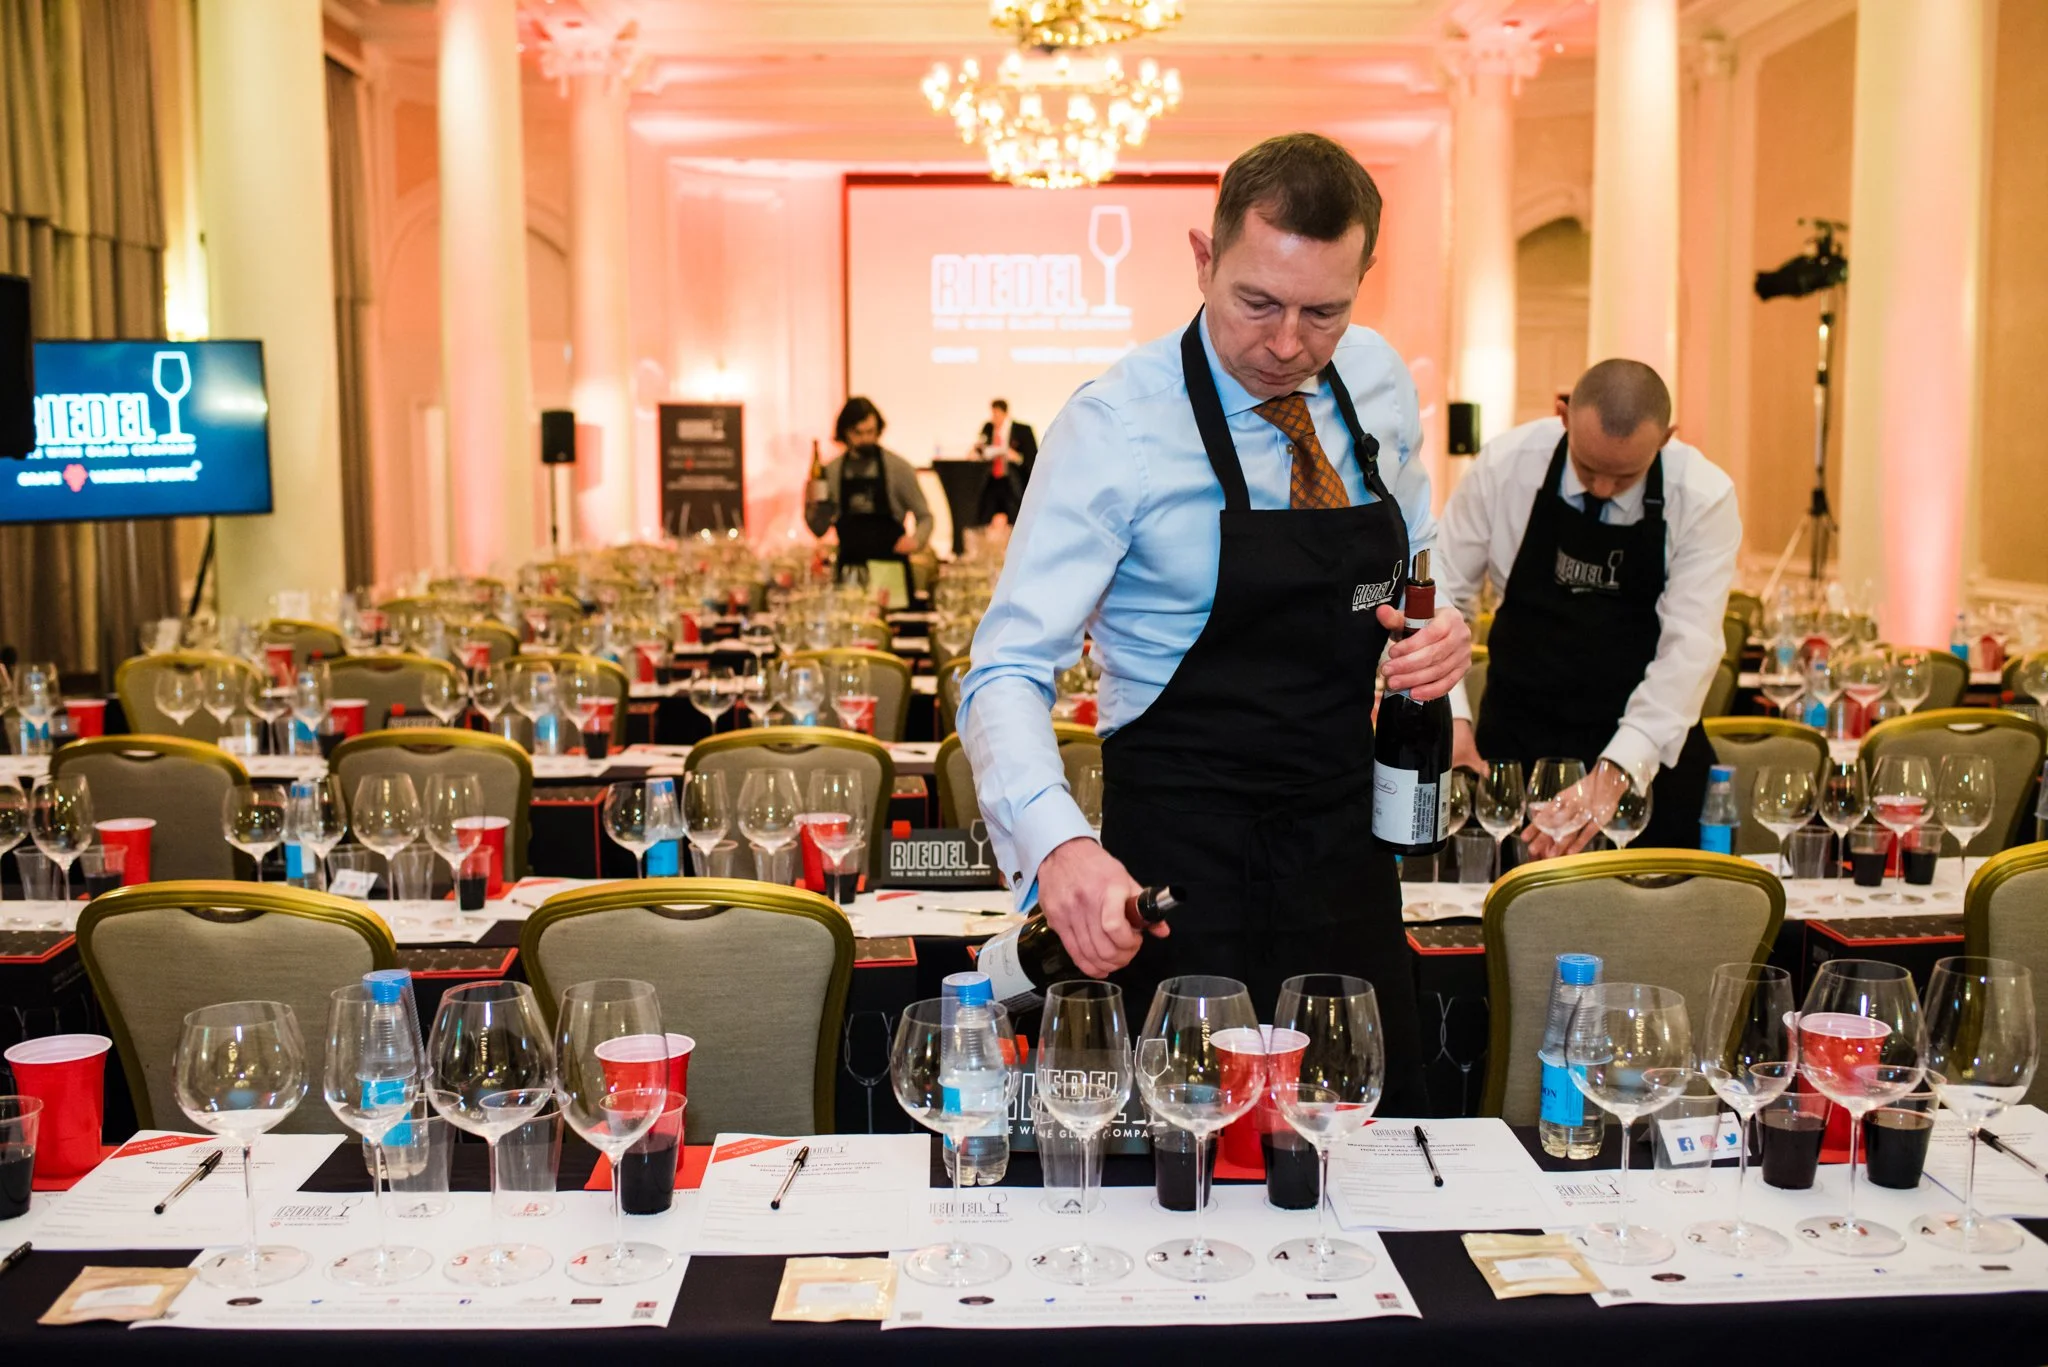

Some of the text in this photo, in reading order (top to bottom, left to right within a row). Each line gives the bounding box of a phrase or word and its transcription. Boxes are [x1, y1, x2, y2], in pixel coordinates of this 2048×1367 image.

[931, 254, 1088, 315] RIEDEL
[34, 393, 157, 446] IEDEL
[1352, 580, 1391, 606] RIEDEL
[890, 841, 969, 870] RIEDEL
[451, 1255, 470, 1267] 3
[571, 1255, 589, 1266] 4
